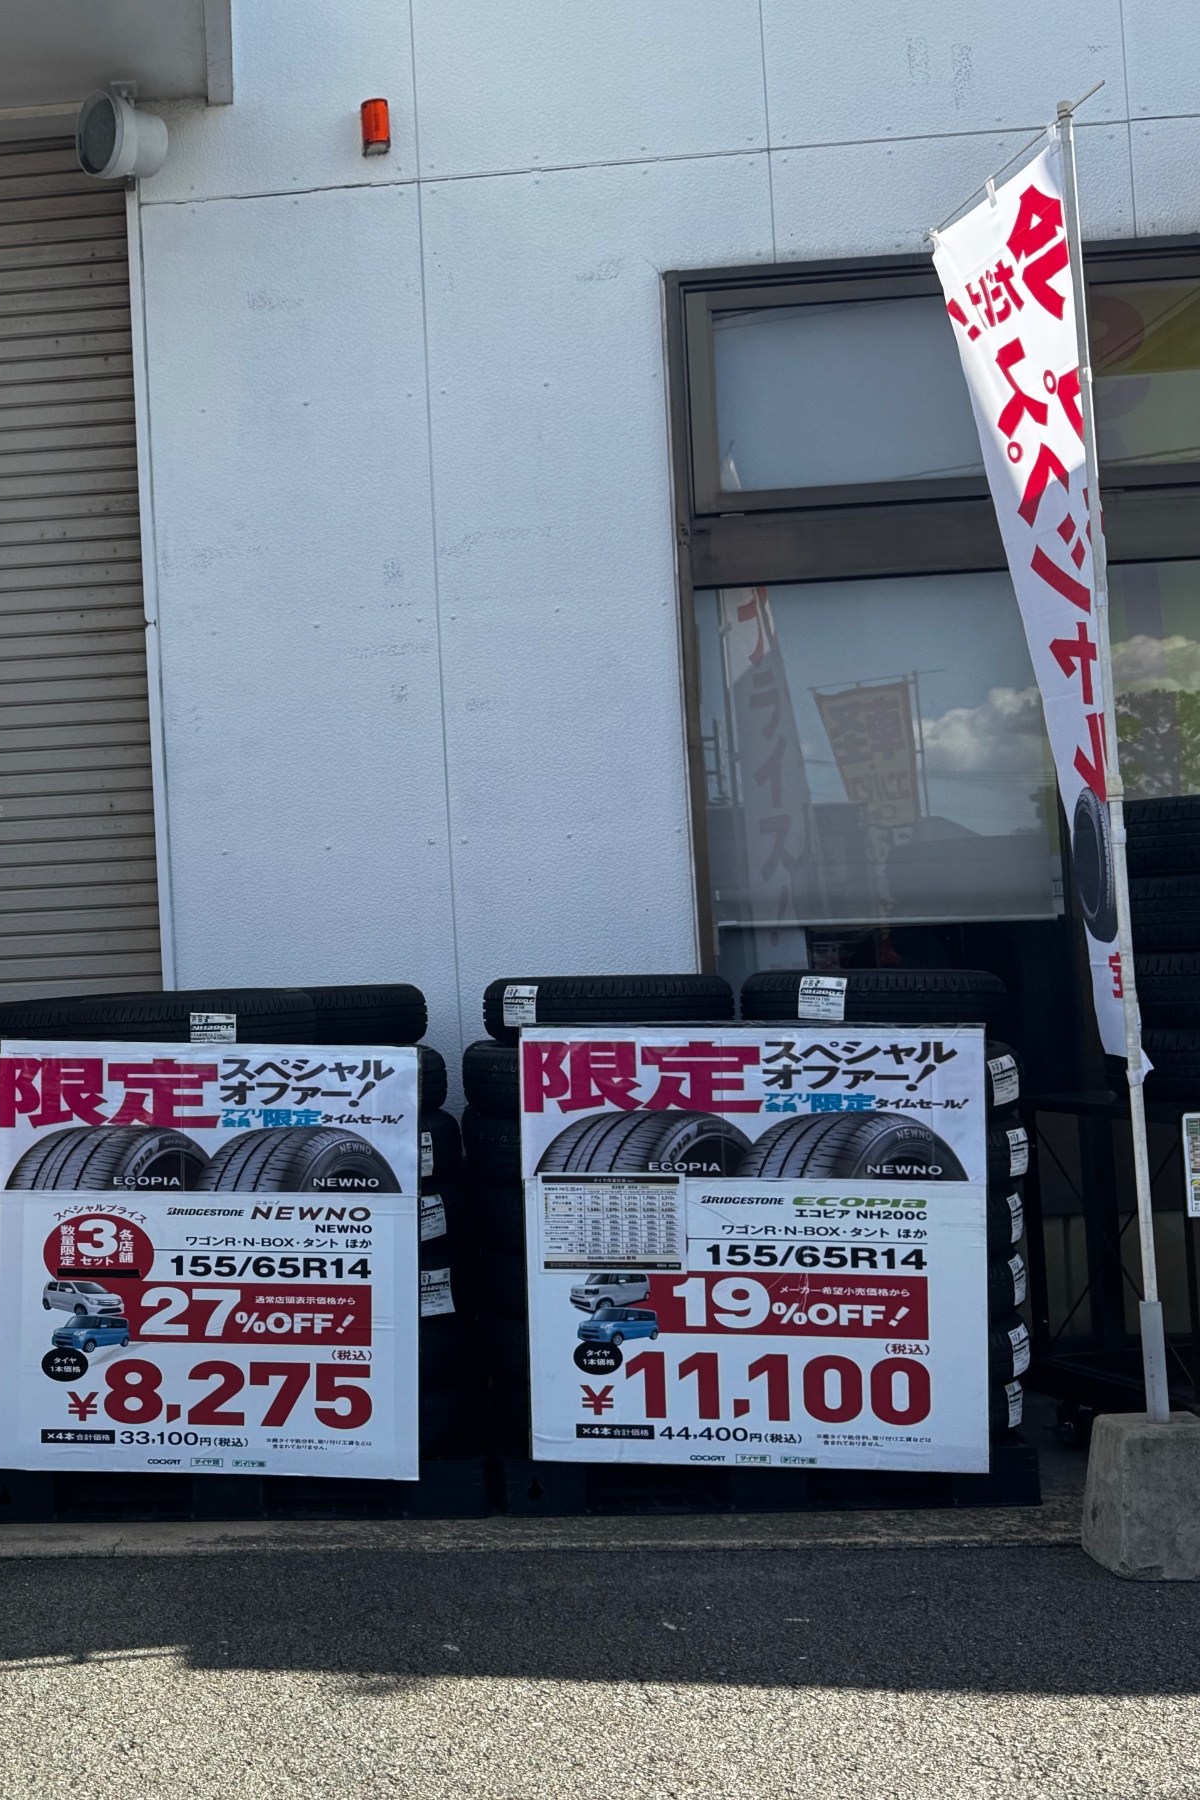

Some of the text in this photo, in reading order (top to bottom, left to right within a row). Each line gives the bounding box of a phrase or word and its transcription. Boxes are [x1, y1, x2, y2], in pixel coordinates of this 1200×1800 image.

[762, 1041, 958, 1066] スペシャル
[220, 1059, 396, 1083] スペシャル
[523, 1041, 766, 1114] 限定
[762, 1064, 937, 1092] オファー!
[220, 1081, 377, 1108] オファー!
[648, 1161, 722, 1172] ECOPIA
[866, 1164, 943, 1175] NEWNO
[112, 1176, 181, 1186] ECOPIA
[312, 1177, 380, 1188] NEWNO
[700, 1195, 785, 1206] BRIDGESTONE
[166, 1206, 245, 1217] BRIDGESTONE
[250, 1205, 372, 1222] NEWNO
[856, 1209, 928, 1221] NH200C
[314, 1224, 373, 1234] NEWNO
[897, 1229, 928, 1239] ほか
[76, 1218, 119, 1258] 3
[345, 1238, 373, 1249] ほか
[60, 1225, 76, 1267] 数量限定
[118, 1228, 134, 1264] 各店舗
[79, 1256, 114, 1266] セット
[706, 1243, 928, 1271] 155/65R14
[170, 1254, 372, 1279] 155/65R14
[779, 1285, 911, 1298] メーカー希望小売価格から
[254, 1295, 356, 1306] 通常店頭表示価格から
[586, 1349, 611, 1358] タイヤ
[884, 1343, 931, 1357] (税込)
[331, 1350, 373, 1362] (税込)
[582, 1358, 616, 1367] 1本価格
[49, 1365, 81, 1373] 1本価格
[147, 1458, 181, 1466] COCKPIT
[689, 1454, 726, 1462] COCKPIT
